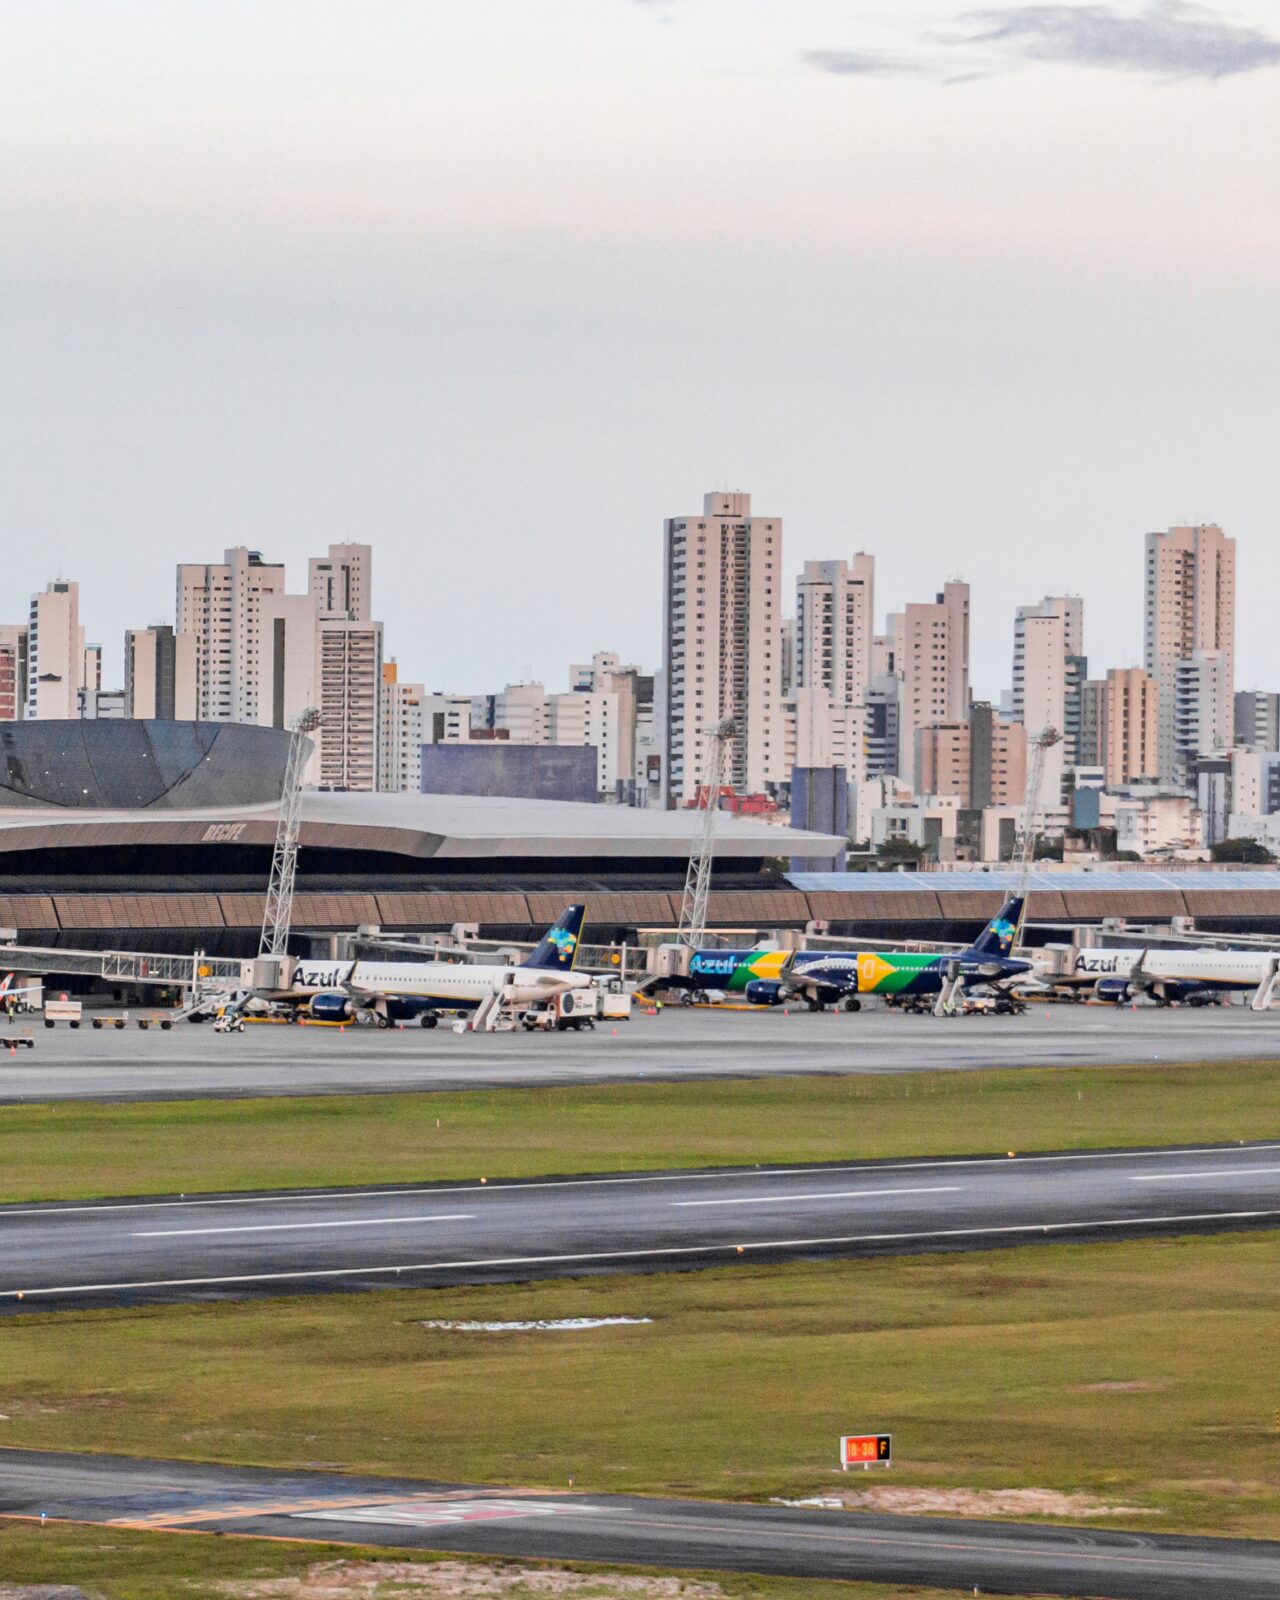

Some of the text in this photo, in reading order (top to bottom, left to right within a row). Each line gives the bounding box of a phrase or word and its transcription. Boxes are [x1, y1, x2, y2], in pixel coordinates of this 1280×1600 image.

[201, 824, 247, 841] RECIFE
[689, 955, 736, 974] Azul
[1075, 956, 1118, 972] Azul
[291, 967, 340, 987] Azul
[880, 1441, 887, 1455] F
